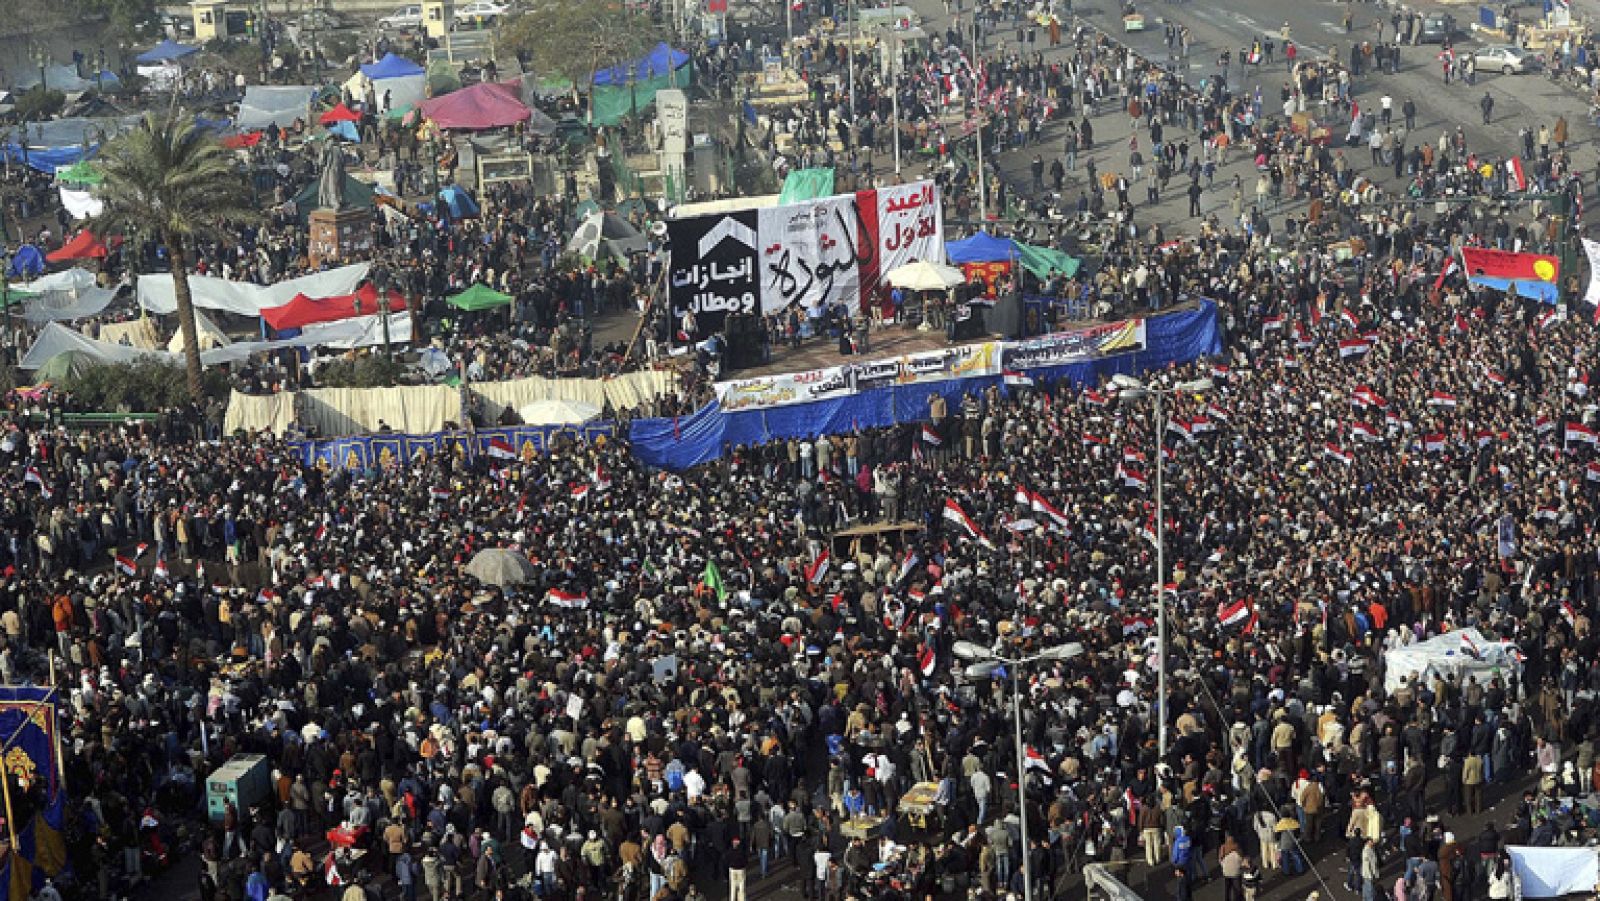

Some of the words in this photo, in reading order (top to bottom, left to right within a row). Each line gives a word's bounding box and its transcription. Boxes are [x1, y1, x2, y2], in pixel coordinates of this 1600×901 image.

[886, 184, 934, 217] العيد
[766, 199, 874, 312] للثورة
[672, 256, 753, 290] إنجازات
